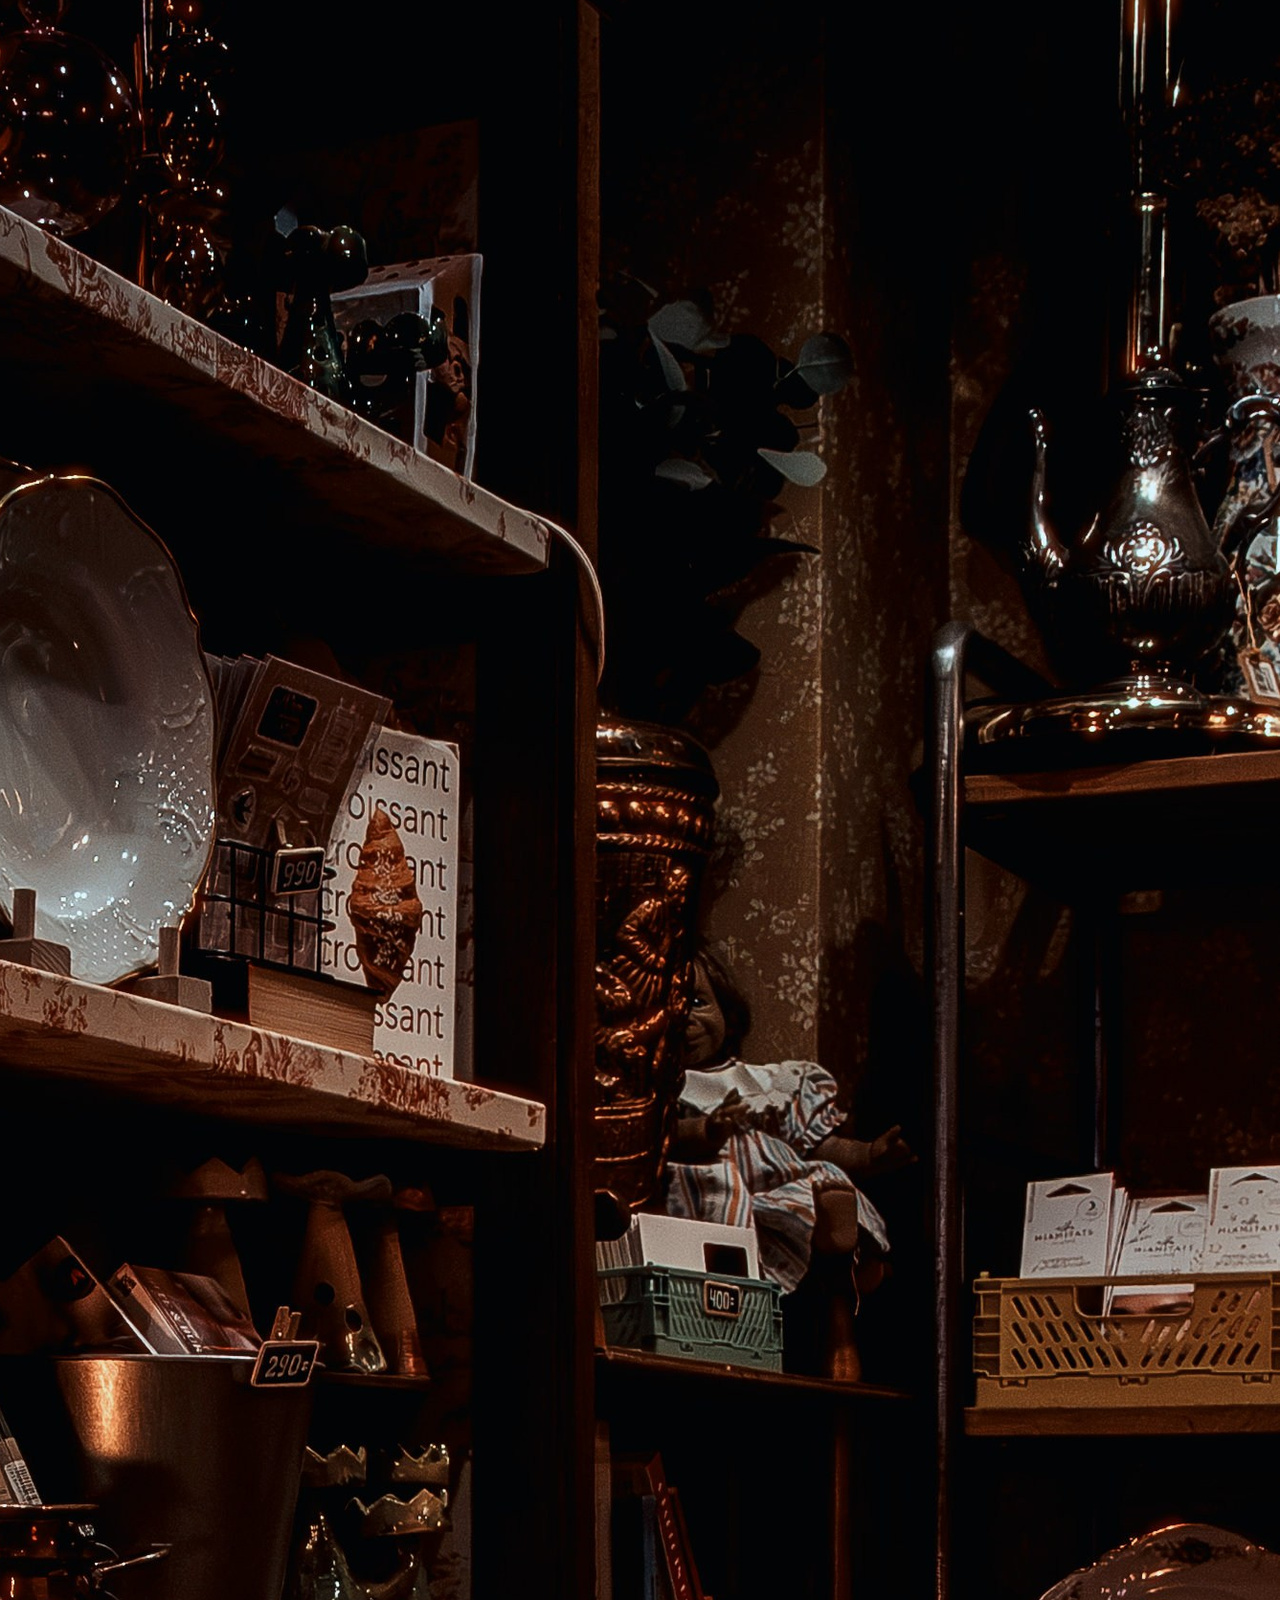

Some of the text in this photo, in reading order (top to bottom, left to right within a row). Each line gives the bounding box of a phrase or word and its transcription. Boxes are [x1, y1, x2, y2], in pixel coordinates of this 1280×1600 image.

[368, 742, 451, 794] issant
[348, 783, 449, 843] oissant
[321, 935, 446, 990] croant
